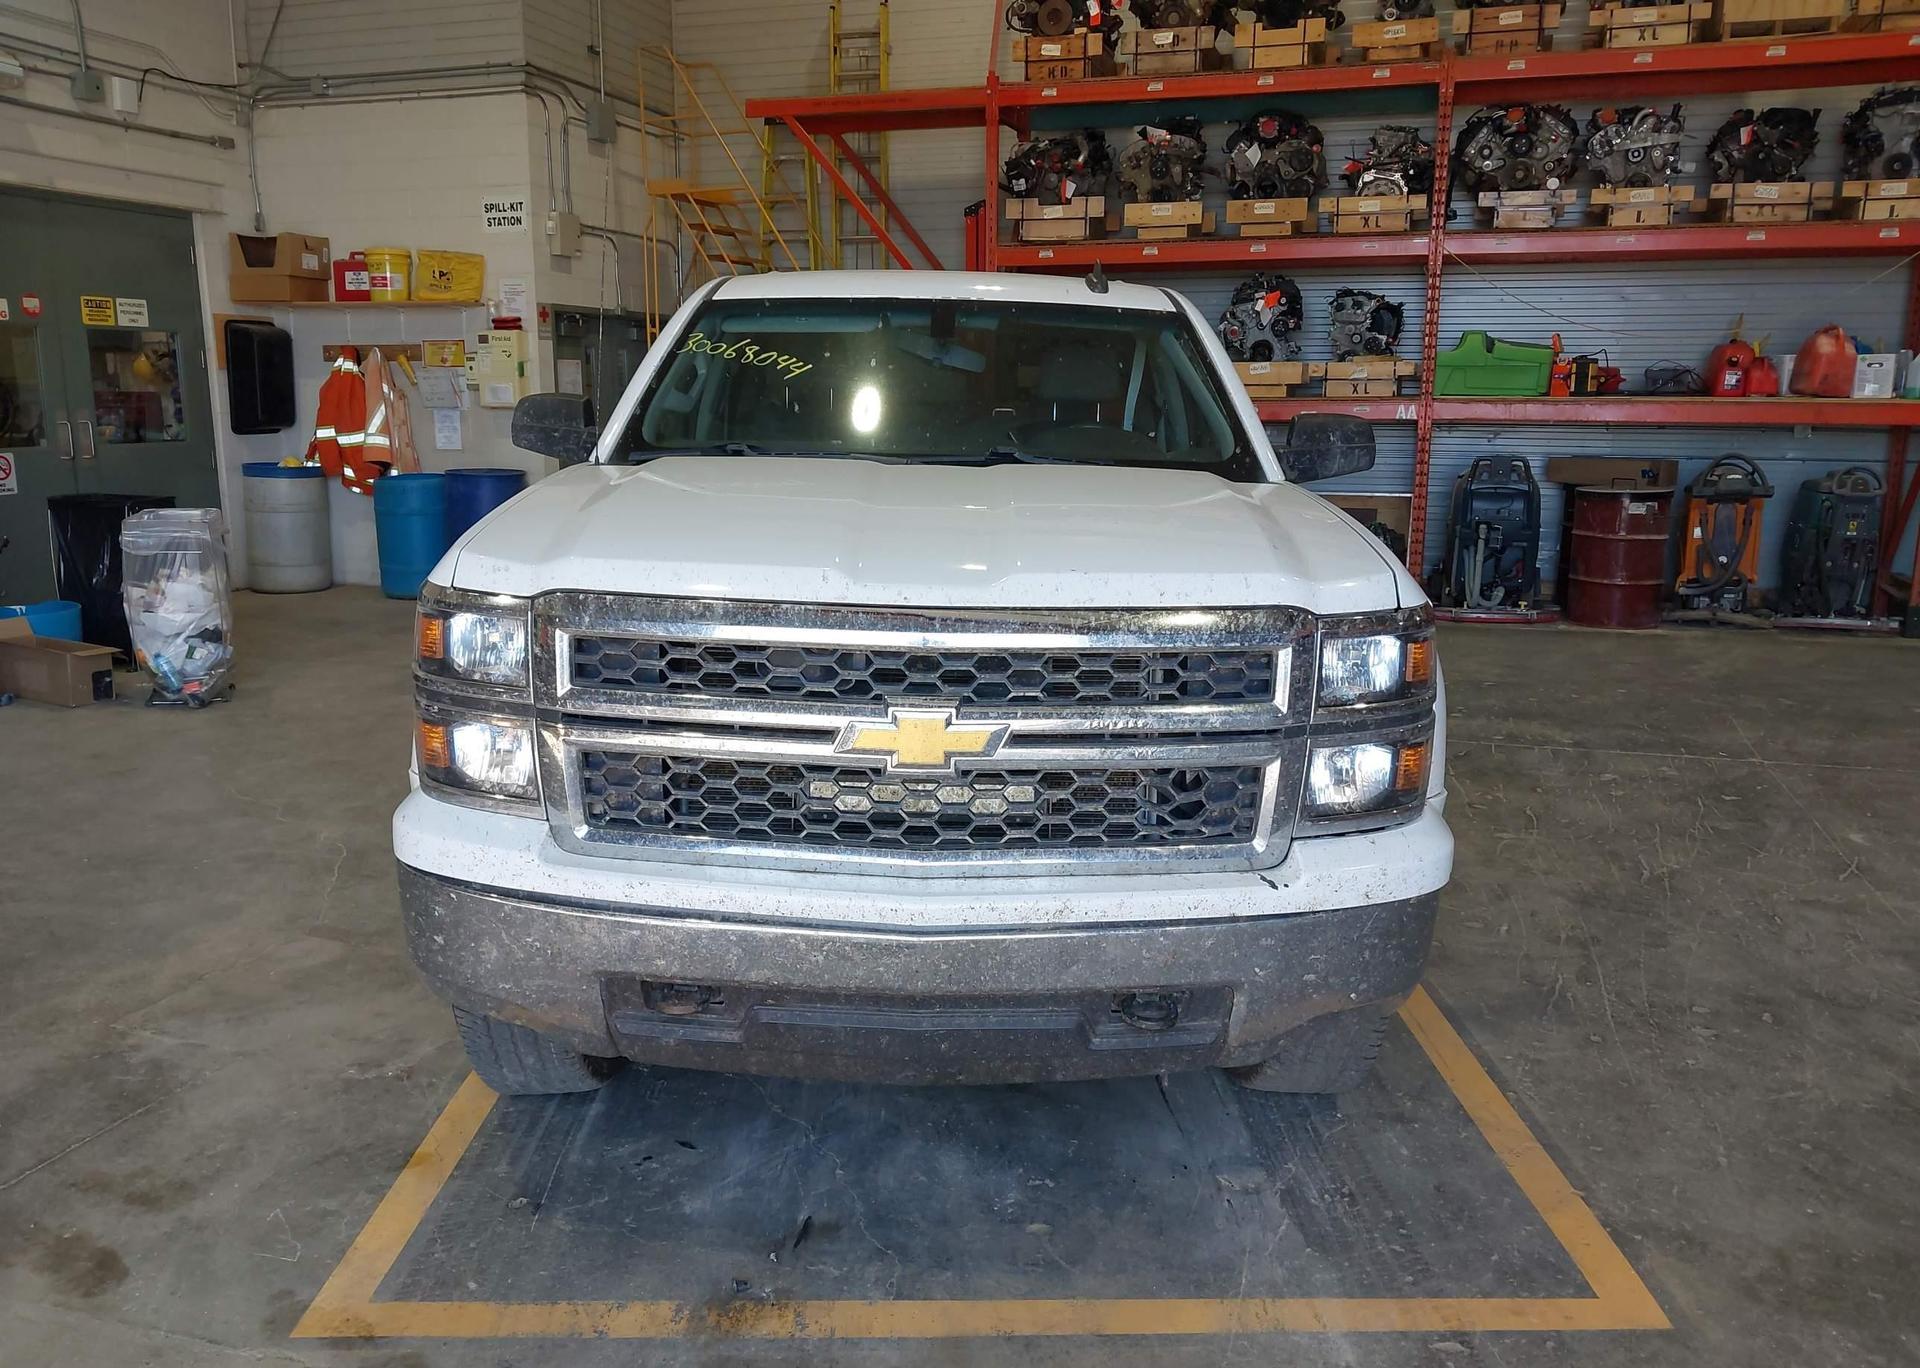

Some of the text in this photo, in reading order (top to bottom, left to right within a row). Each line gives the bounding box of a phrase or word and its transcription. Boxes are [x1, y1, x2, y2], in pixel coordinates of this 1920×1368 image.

[484, 201, 523, 213] SPILL-KIT
[487, 215, 522, 227] STATION
[676, 332, 813, 380] 30068044
[1352, 383, 1370, 395] XL
[1395, 404, 1417, 419] AA
